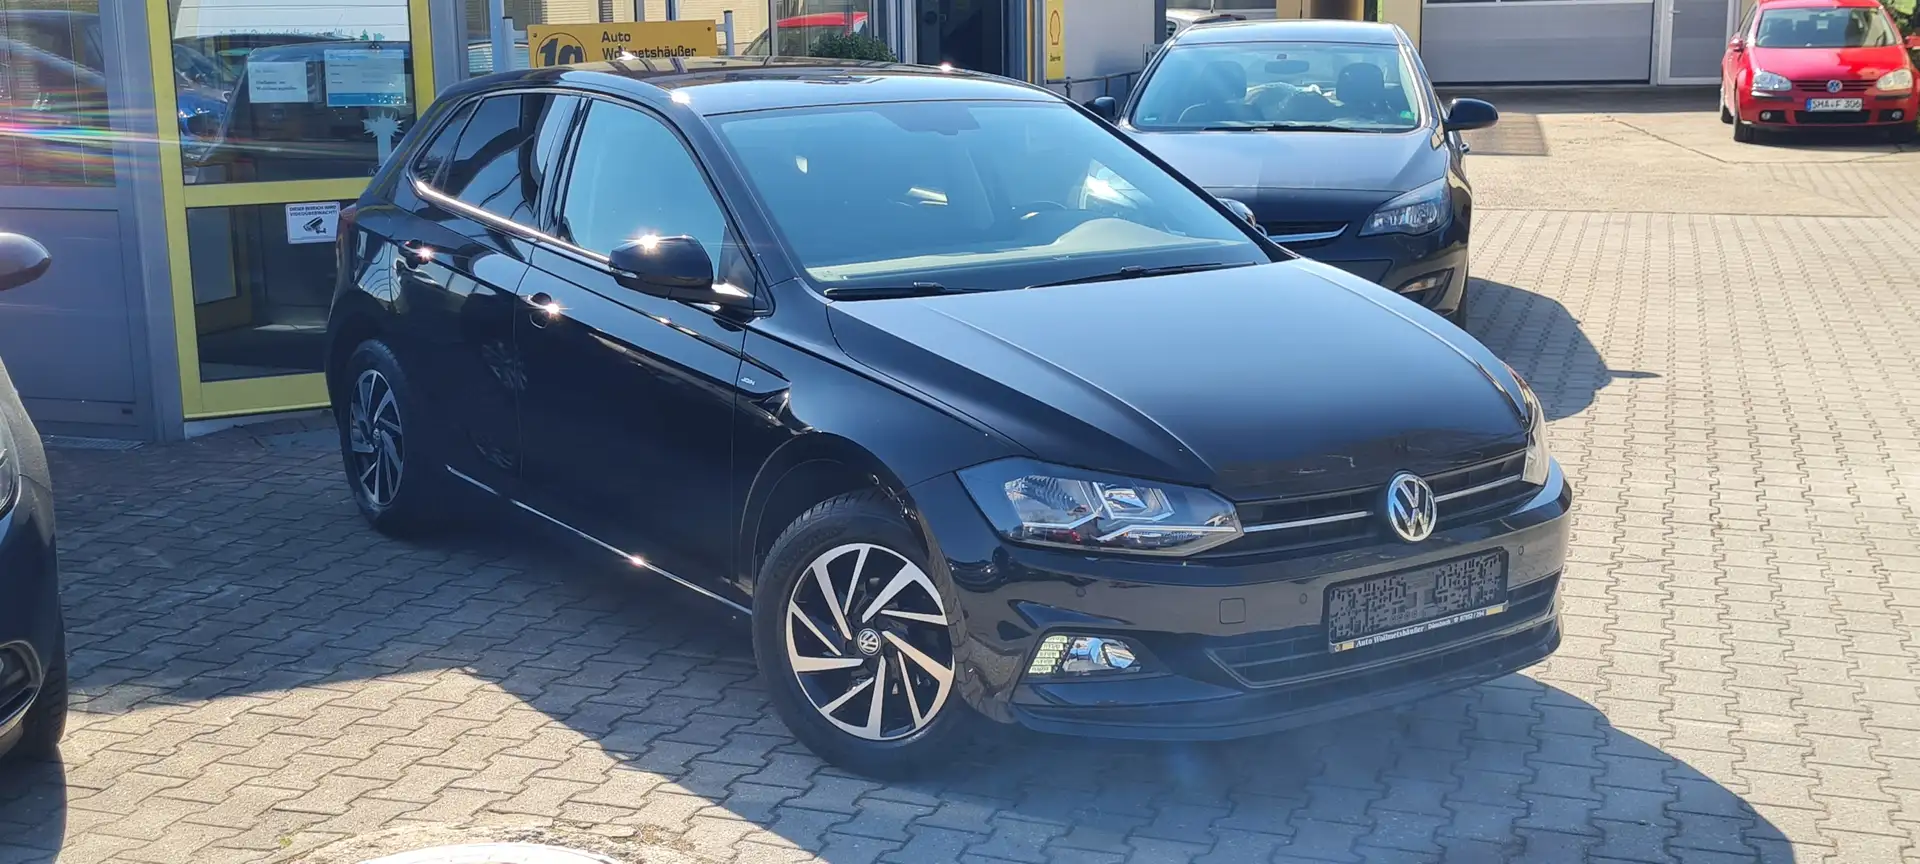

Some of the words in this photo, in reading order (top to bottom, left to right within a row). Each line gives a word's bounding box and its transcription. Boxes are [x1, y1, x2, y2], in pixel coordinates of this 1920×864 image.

[601, 31, 631, 43] Auto
[602, 45, 697, 61] Wometshäußer
[1355, 637, 1373, 648] Auto
